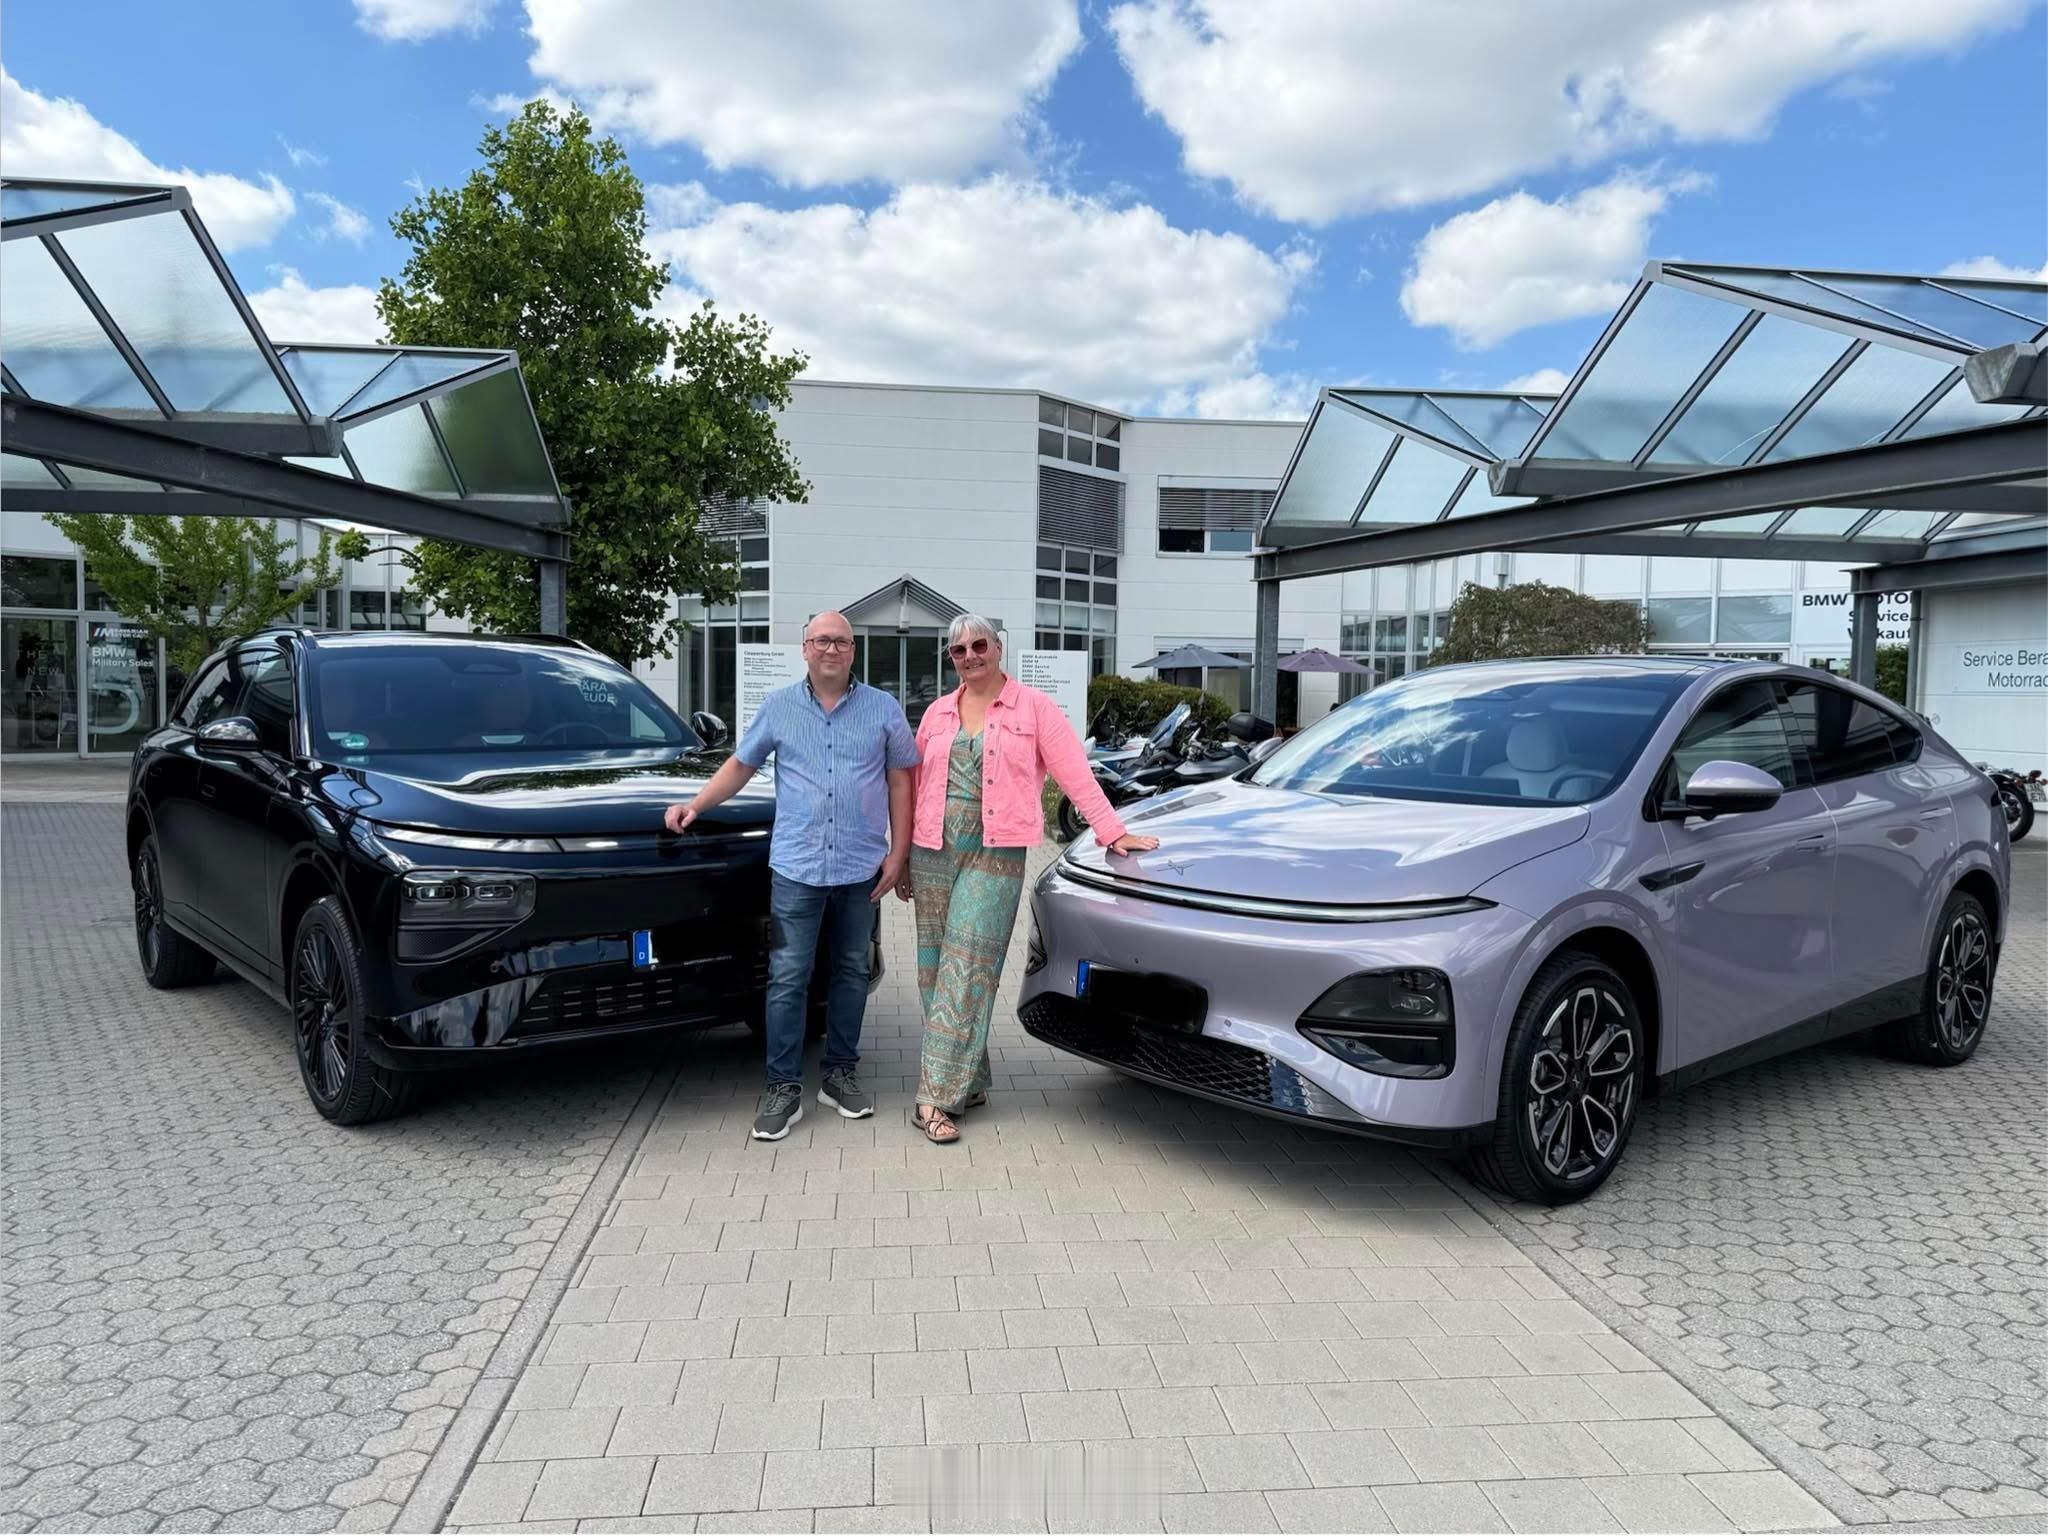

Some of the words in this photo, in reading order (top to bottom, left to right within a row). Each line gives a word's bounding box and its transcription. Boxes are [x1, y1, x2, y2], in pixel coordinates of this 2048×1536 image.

[1802, 594, 1848, 606] BMW
[1848, 610, 1909, 621] Svice
[92, 647, 126, 657] BMW
[92, 658, 127, 668] Military
[128, 658, 154, 667] Sales
[1963, 651, 2014, 667] Service
[27, 666, 60, 675] NEW
[639, 952, 646, 960] D
